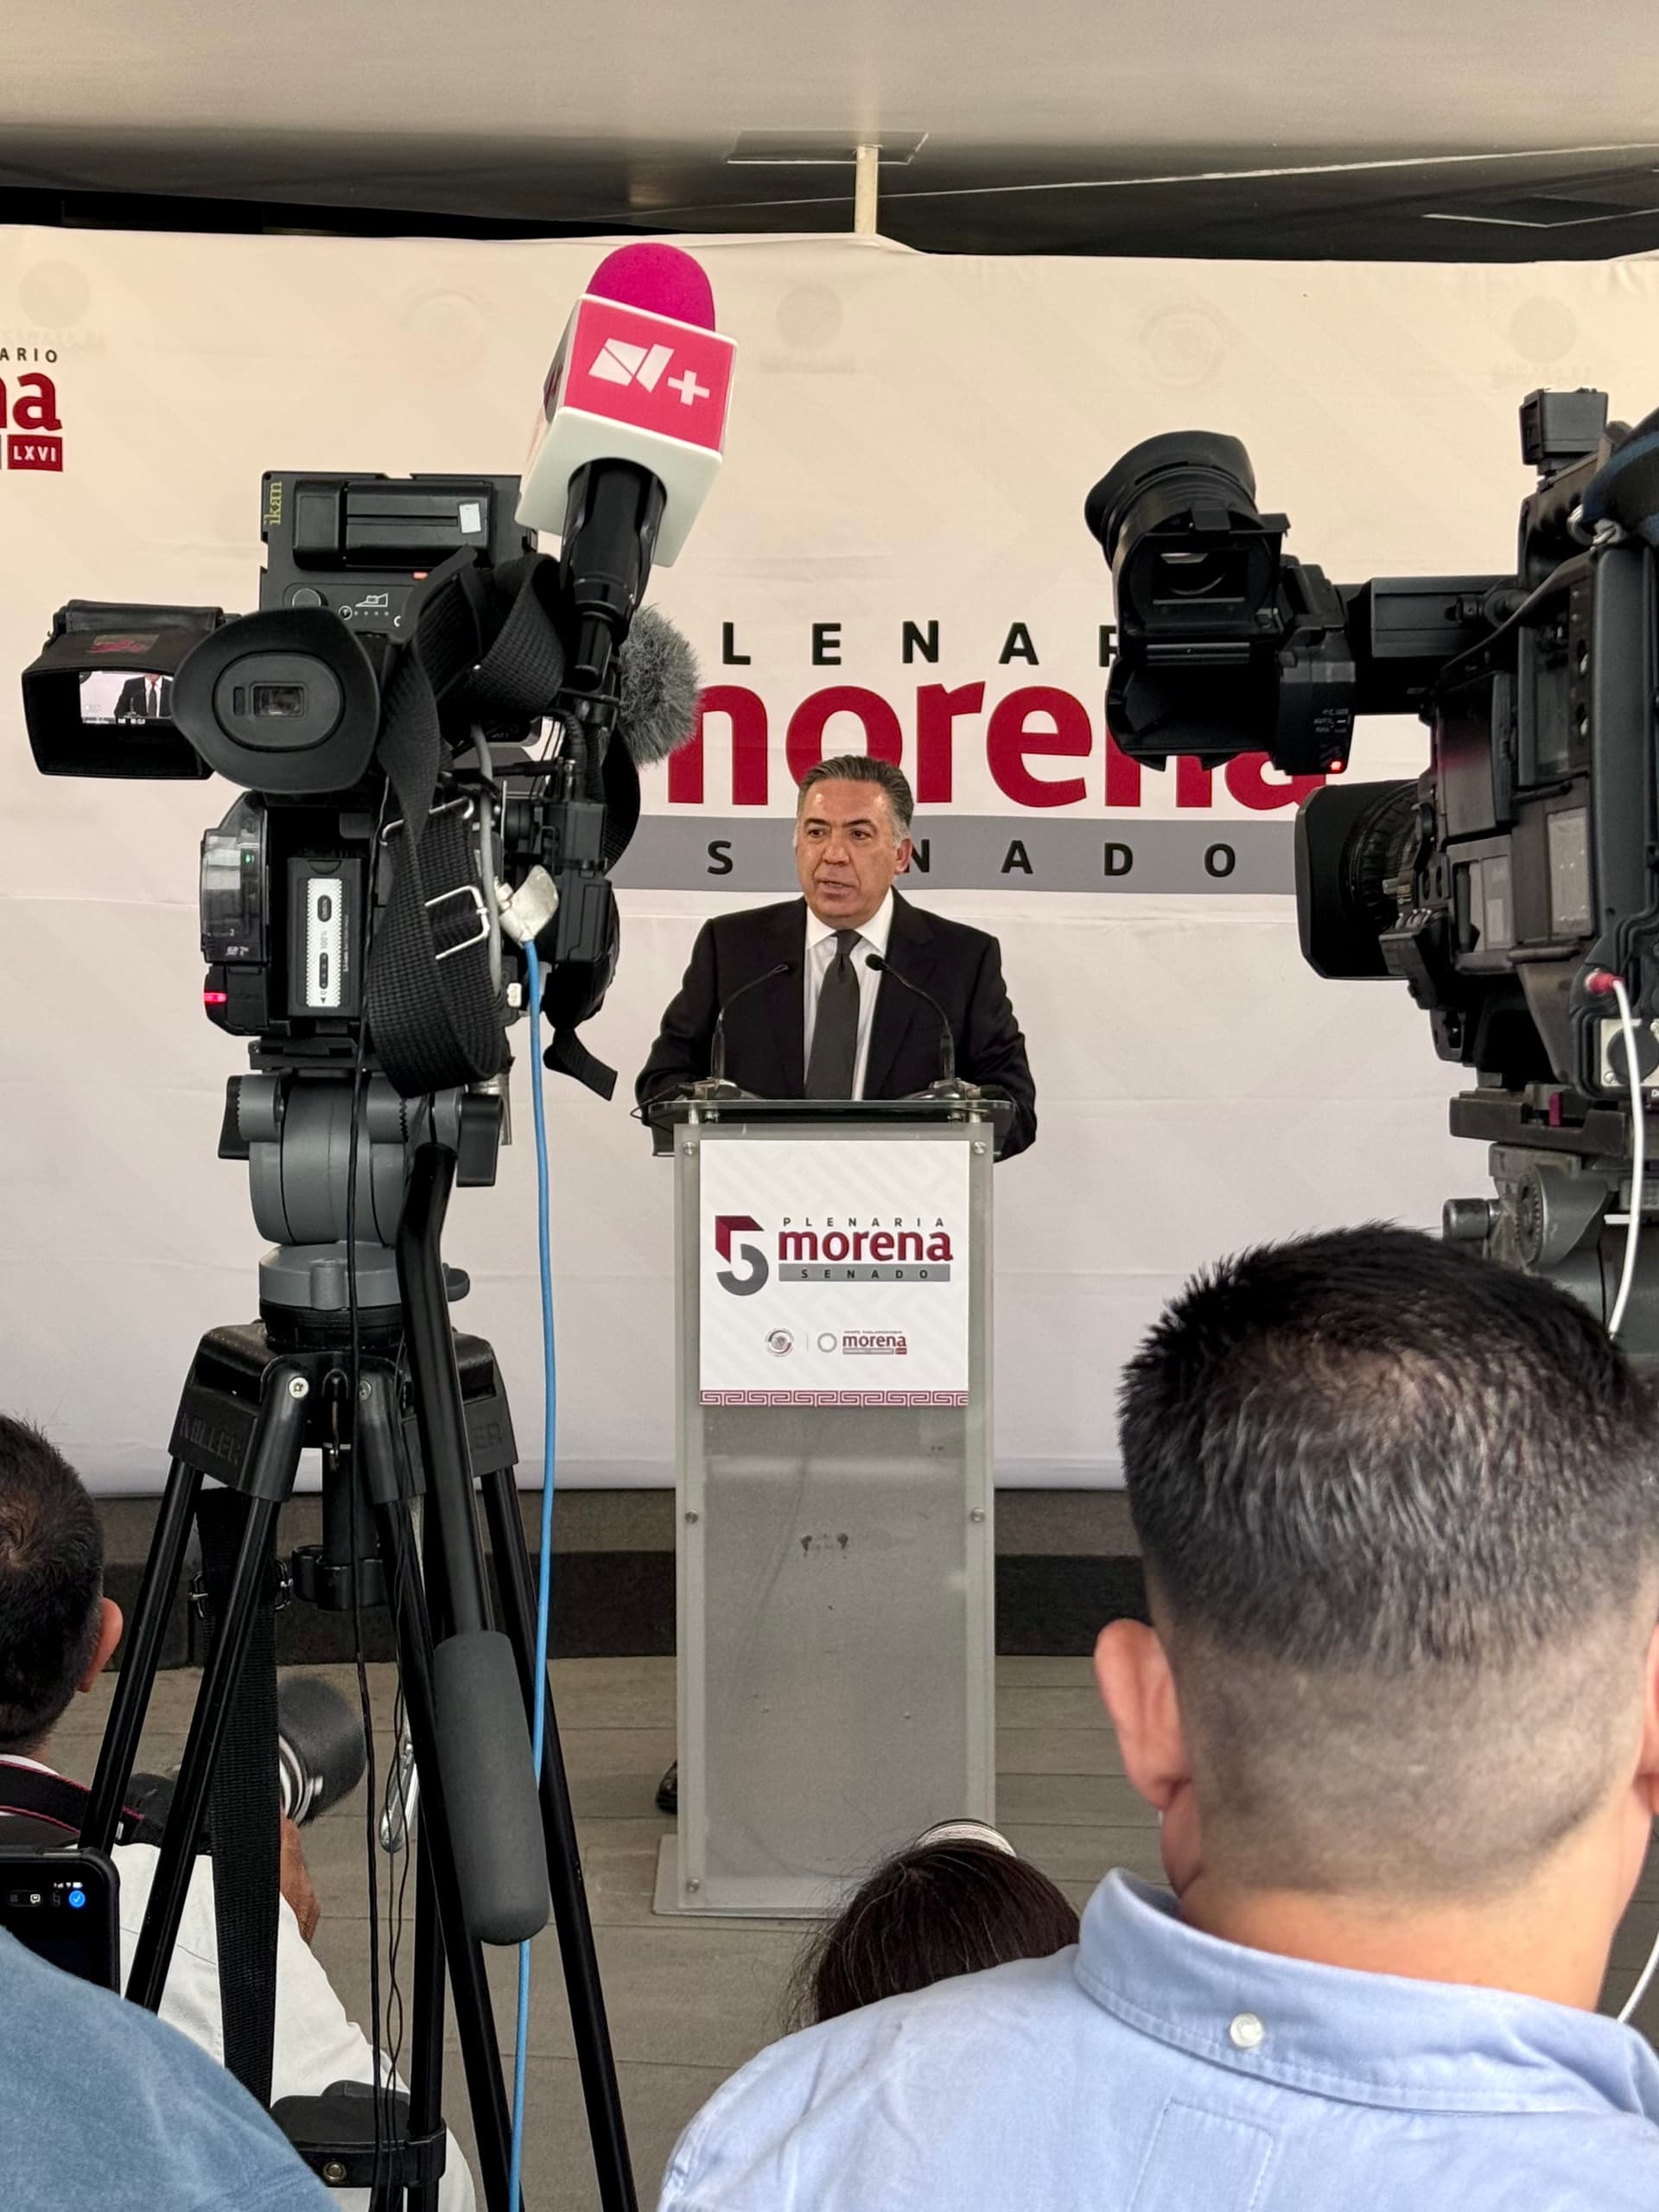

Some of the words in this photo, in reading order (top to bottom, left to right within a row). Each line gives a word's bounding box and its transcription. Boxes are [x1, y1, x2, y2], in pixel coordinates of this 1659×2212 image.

[0, 347, 58, 363] ARIO
[0, 372, 62, 431] a
[13, 445, 56, 462] LXVI
[264, 481, 283, 525] ikan
[707, 839, 1236, 878] SNADO
[783, 1217, 944, 1227] PLENARIA
[779, 1230, 954, 1262] morena
[801, 1268, 929, 1280] SENADO
[842, 1335, 906, 1347] morena
